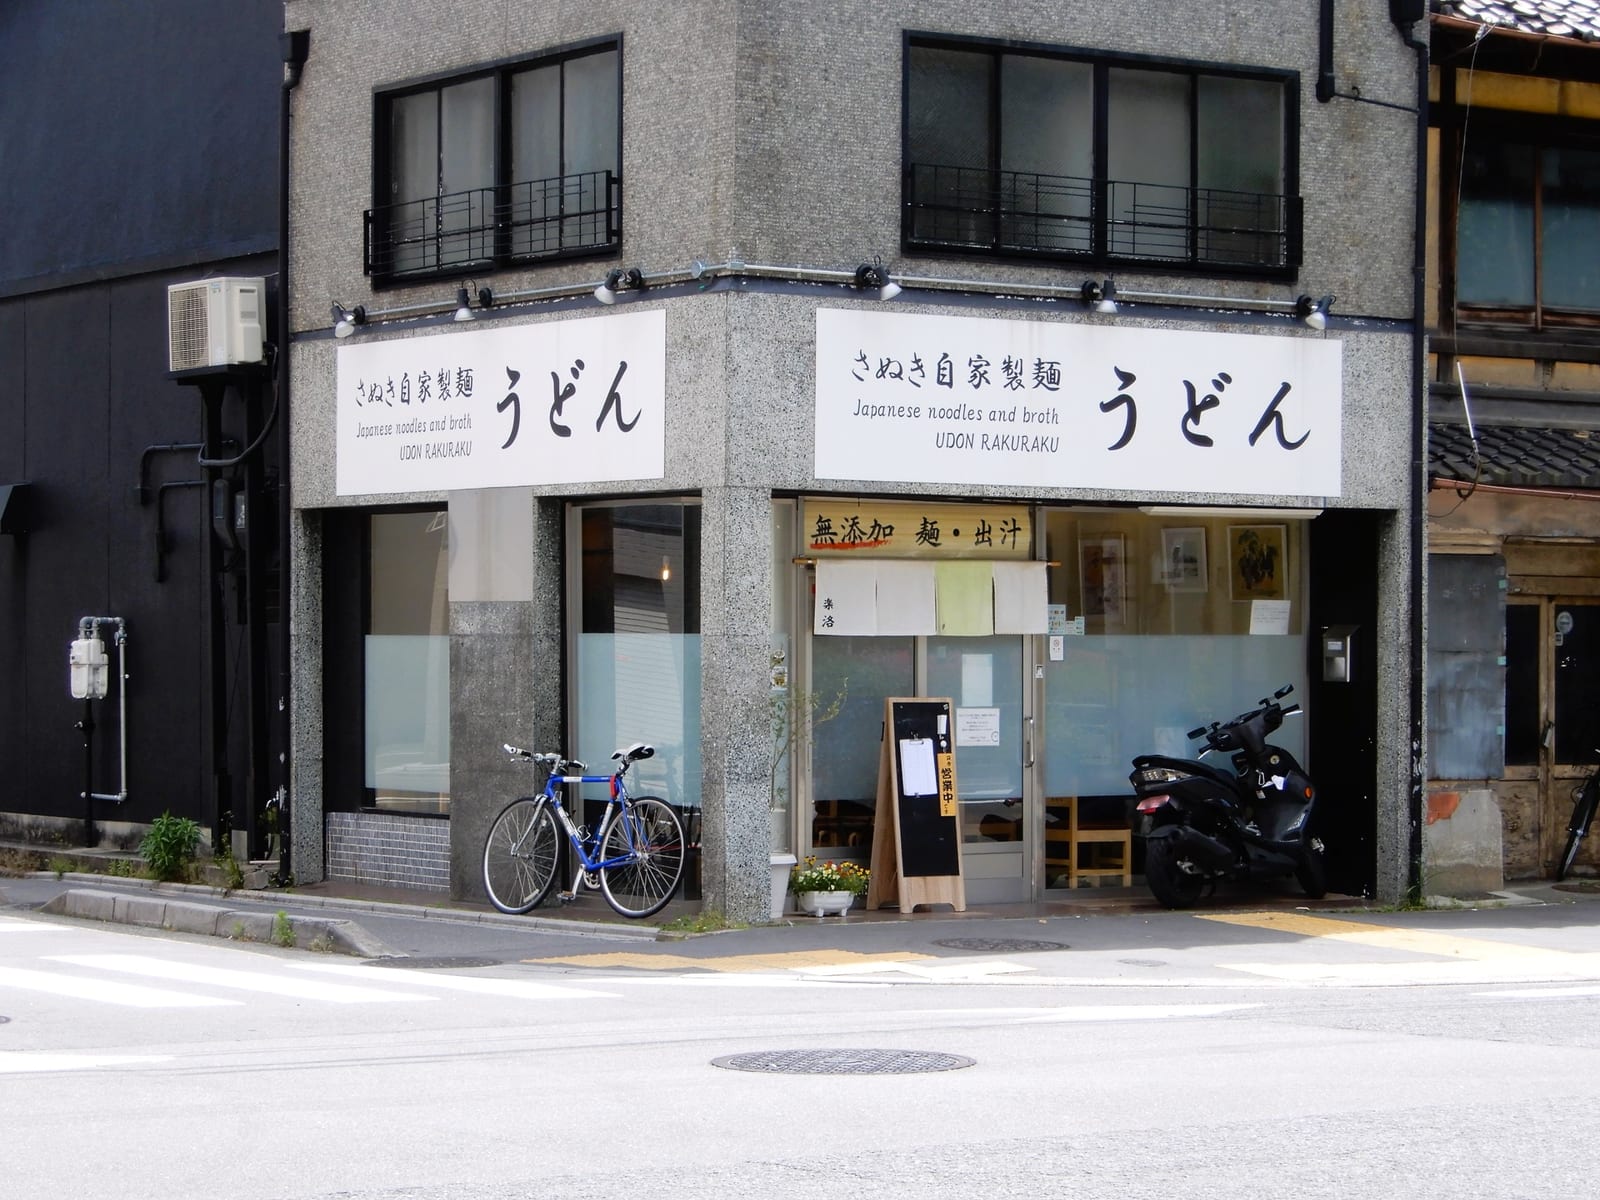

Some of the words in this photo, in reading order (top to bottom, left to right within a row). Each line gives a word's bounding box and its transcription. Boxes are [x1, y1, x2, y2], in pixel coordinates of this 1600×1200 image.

[851, 349, 1062, 392] さぬき自家製麺
[356, 366, 474, 408] さぬき自家製麺
[496, 358, 642, 450] うどん
[852, 398, 921, 419] Japanese
[927, 403, 983, 422] noodles
[988, 405, 1017, 423] and
[1022, 406, 1059, 425] broth
[1099, 365, 1311, 451] うどん
[356, 419, 393, 438] Japanese
[395, 417, 427, 435] noodles
[429, 415, 447, 432] and
[449, 413, 472, 431] broth
[399, 444, 423, 461] UDON
[425, 440, 472, 460] RAKURAKU
[935, 431, 975, 449] UDON
[980, 433, 1060, 453] RAKURAKU
[810, 514, 895, 545] 無添加
